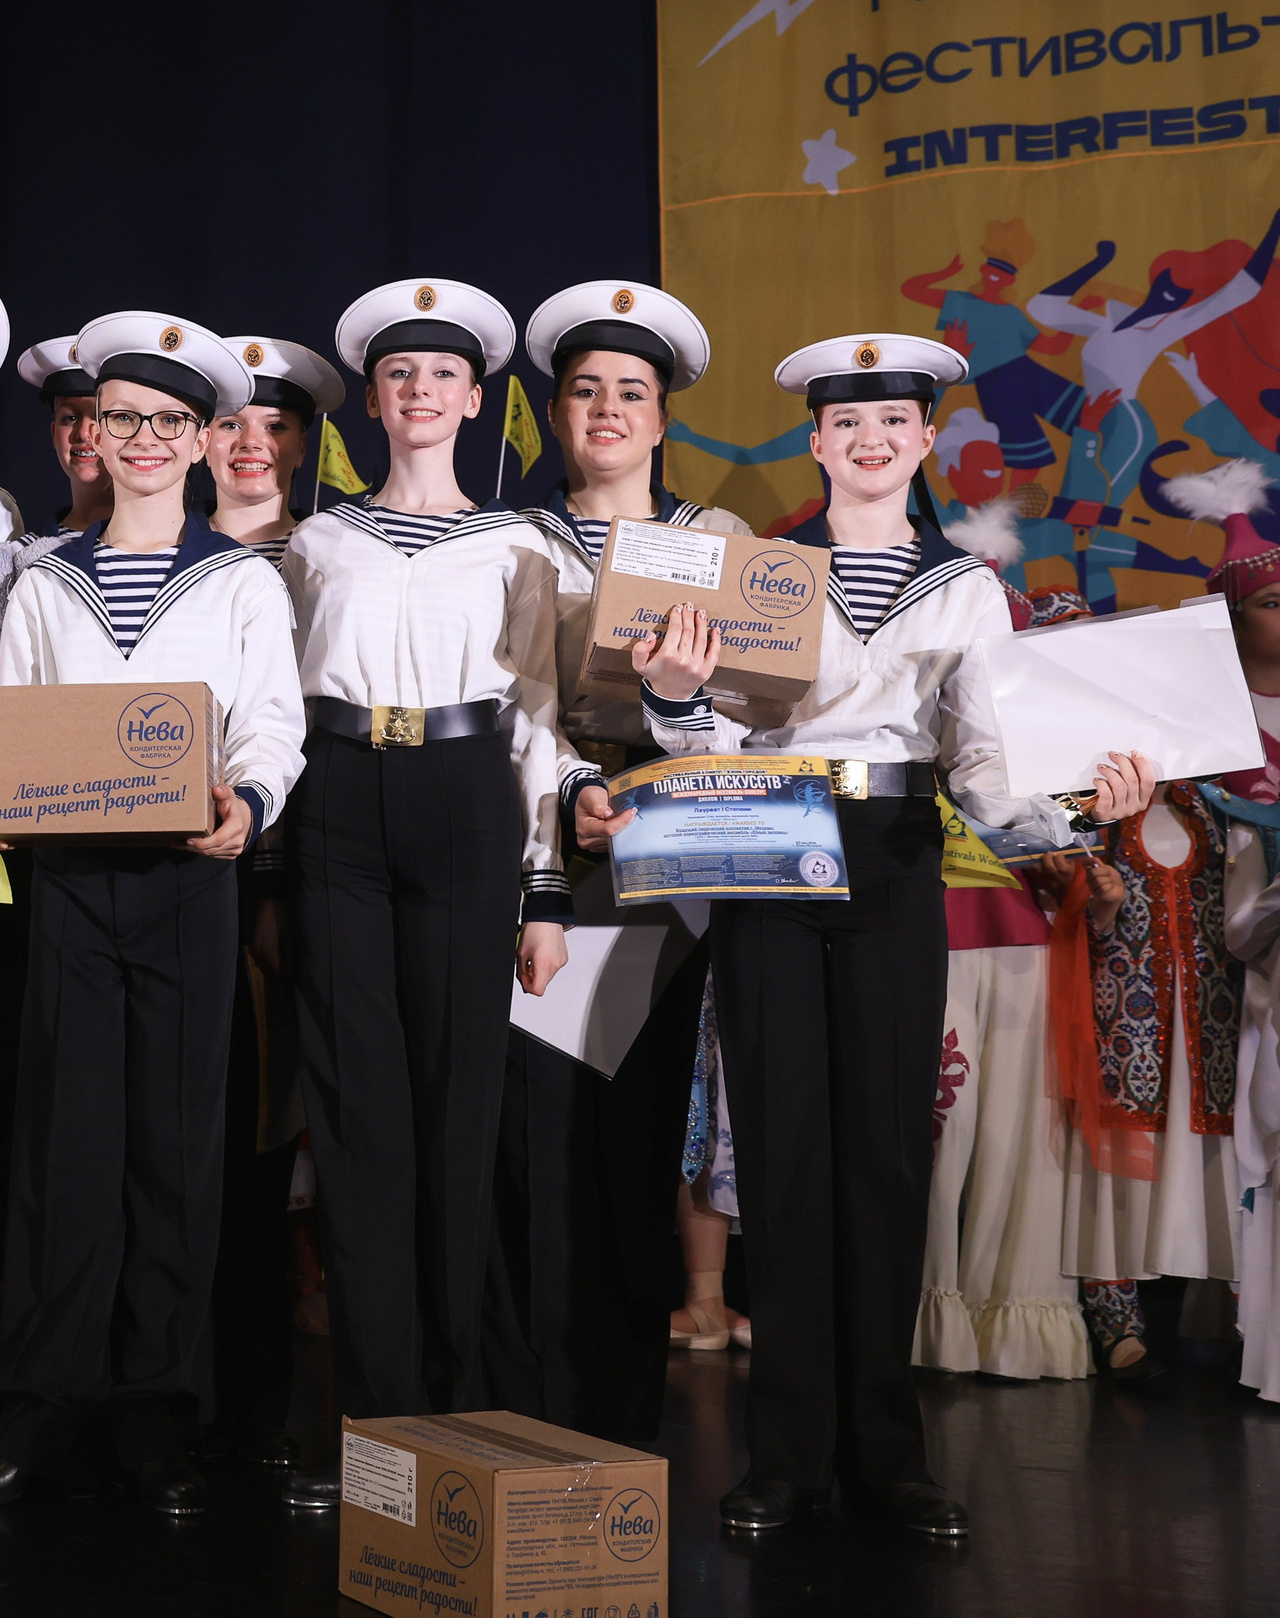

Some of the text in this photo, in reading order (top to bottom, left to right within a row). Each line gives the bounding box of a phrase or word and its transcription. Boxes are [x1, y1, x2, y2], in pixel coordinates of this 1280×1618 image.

[749, 571, 806, 598] Нева
[750, 594, 801, 606] КОНДИТЕРСКАЯ
[759, 602, 790, 611] ФАБРИКА
[630, 607, 670, 625] Лёгк
[613, 626, 648, 639] наш
[720, 635, 801, 654] радости!
[127, 720, 185, 742] Нева
[13, 782, 69, 801] Лёгкие
[72, 774, 157, 798] сладости
[653, 774, 782, 795] ПЛАНЕТА ИСКУССТВ
[36, 798, 101, 823] рецепт
[103, 784, 187, 816] радости!
[437, 1500, 477, 1540] Нева
[610, 1515, 653, 1537] Нева
[359, 1545, 396, 1572] Лёгкие
[399, 1560, 456, 1588] сладости
[349, 1569, 373, 1588] наш
[375, 1575, 418, 1600] рецепт
[419, 1588, 478, 1617] радости!
